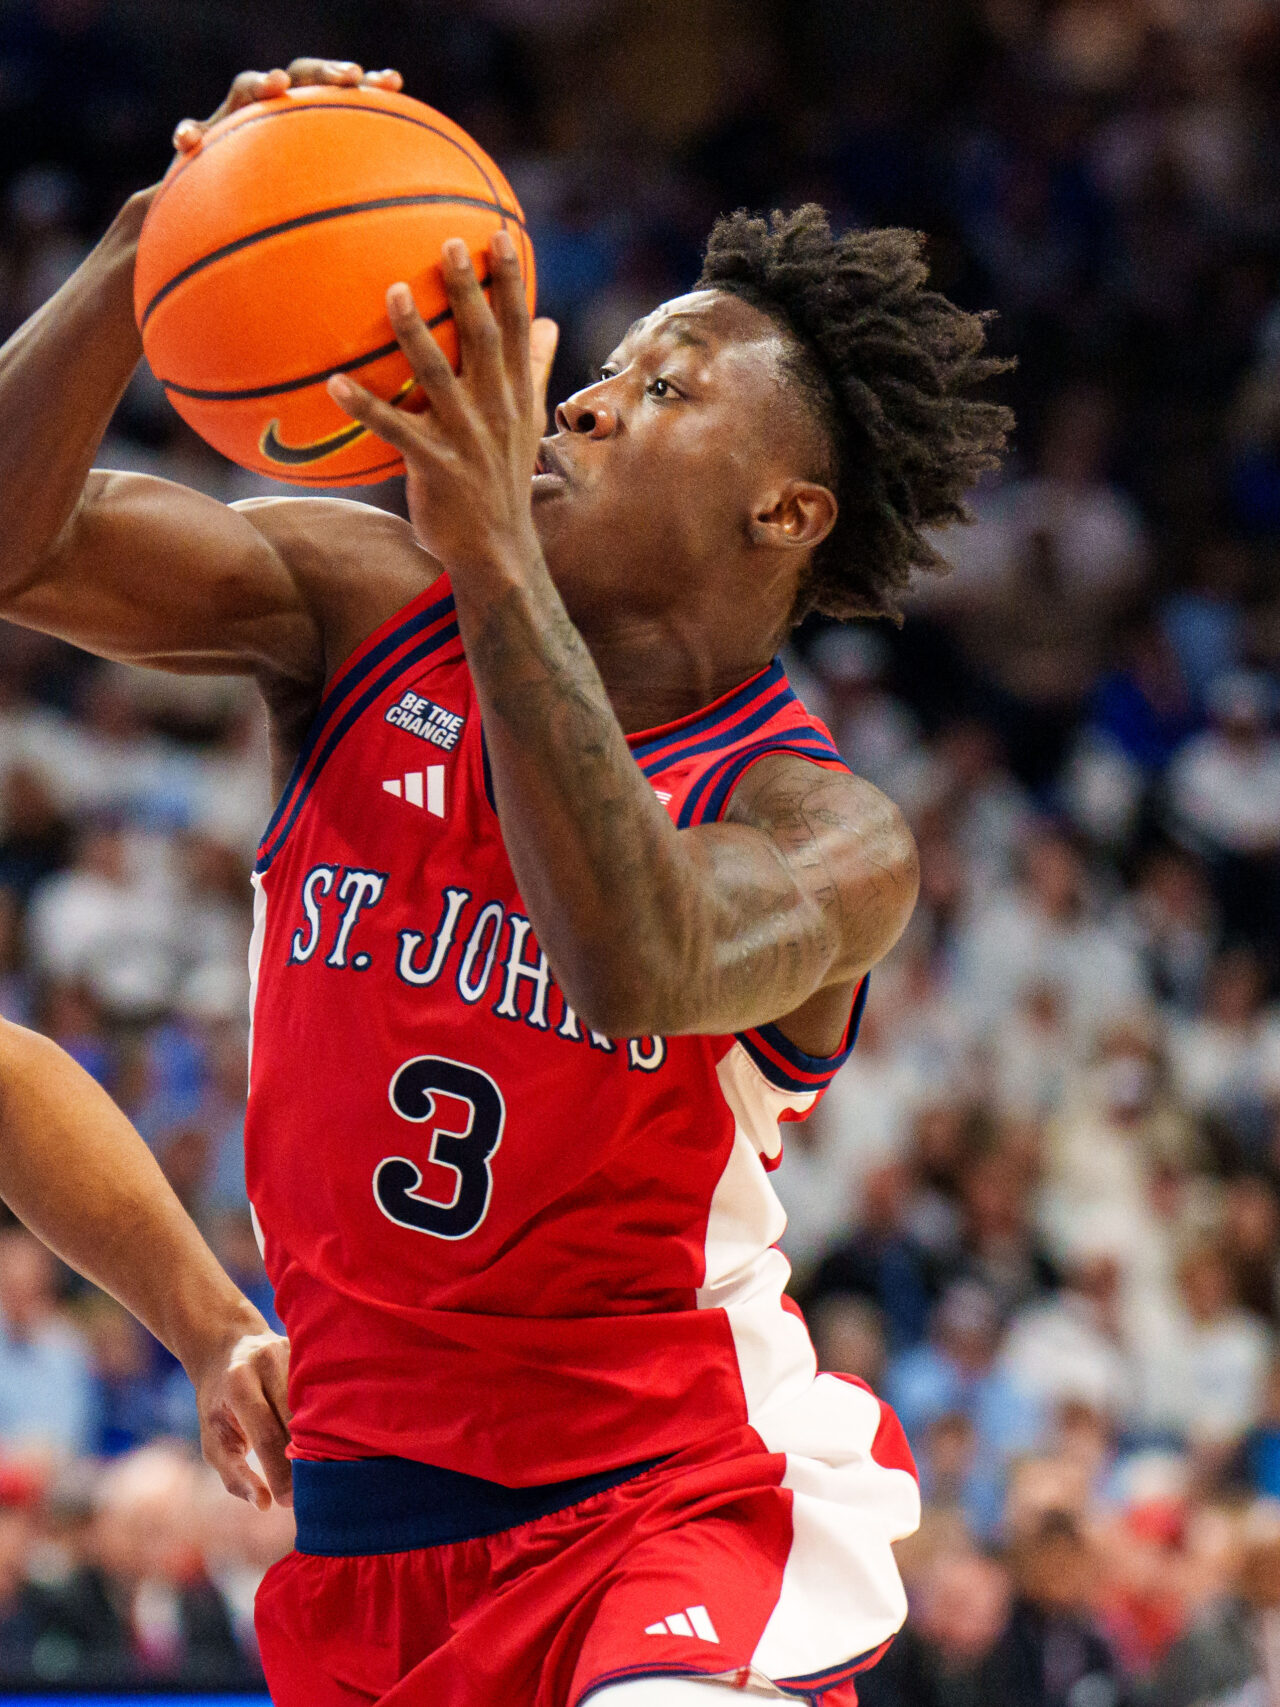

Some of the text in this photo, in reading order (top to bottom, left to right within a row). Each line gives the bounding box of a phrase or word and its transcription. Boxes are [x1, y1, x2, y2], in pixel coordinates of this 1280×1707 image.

[385, 706, 459, 750] CHANGE
[400, 692, 464, 732] BE THE
[287, 863, 389, 972] ST.
[372, 1054, 506, 1241] 3
